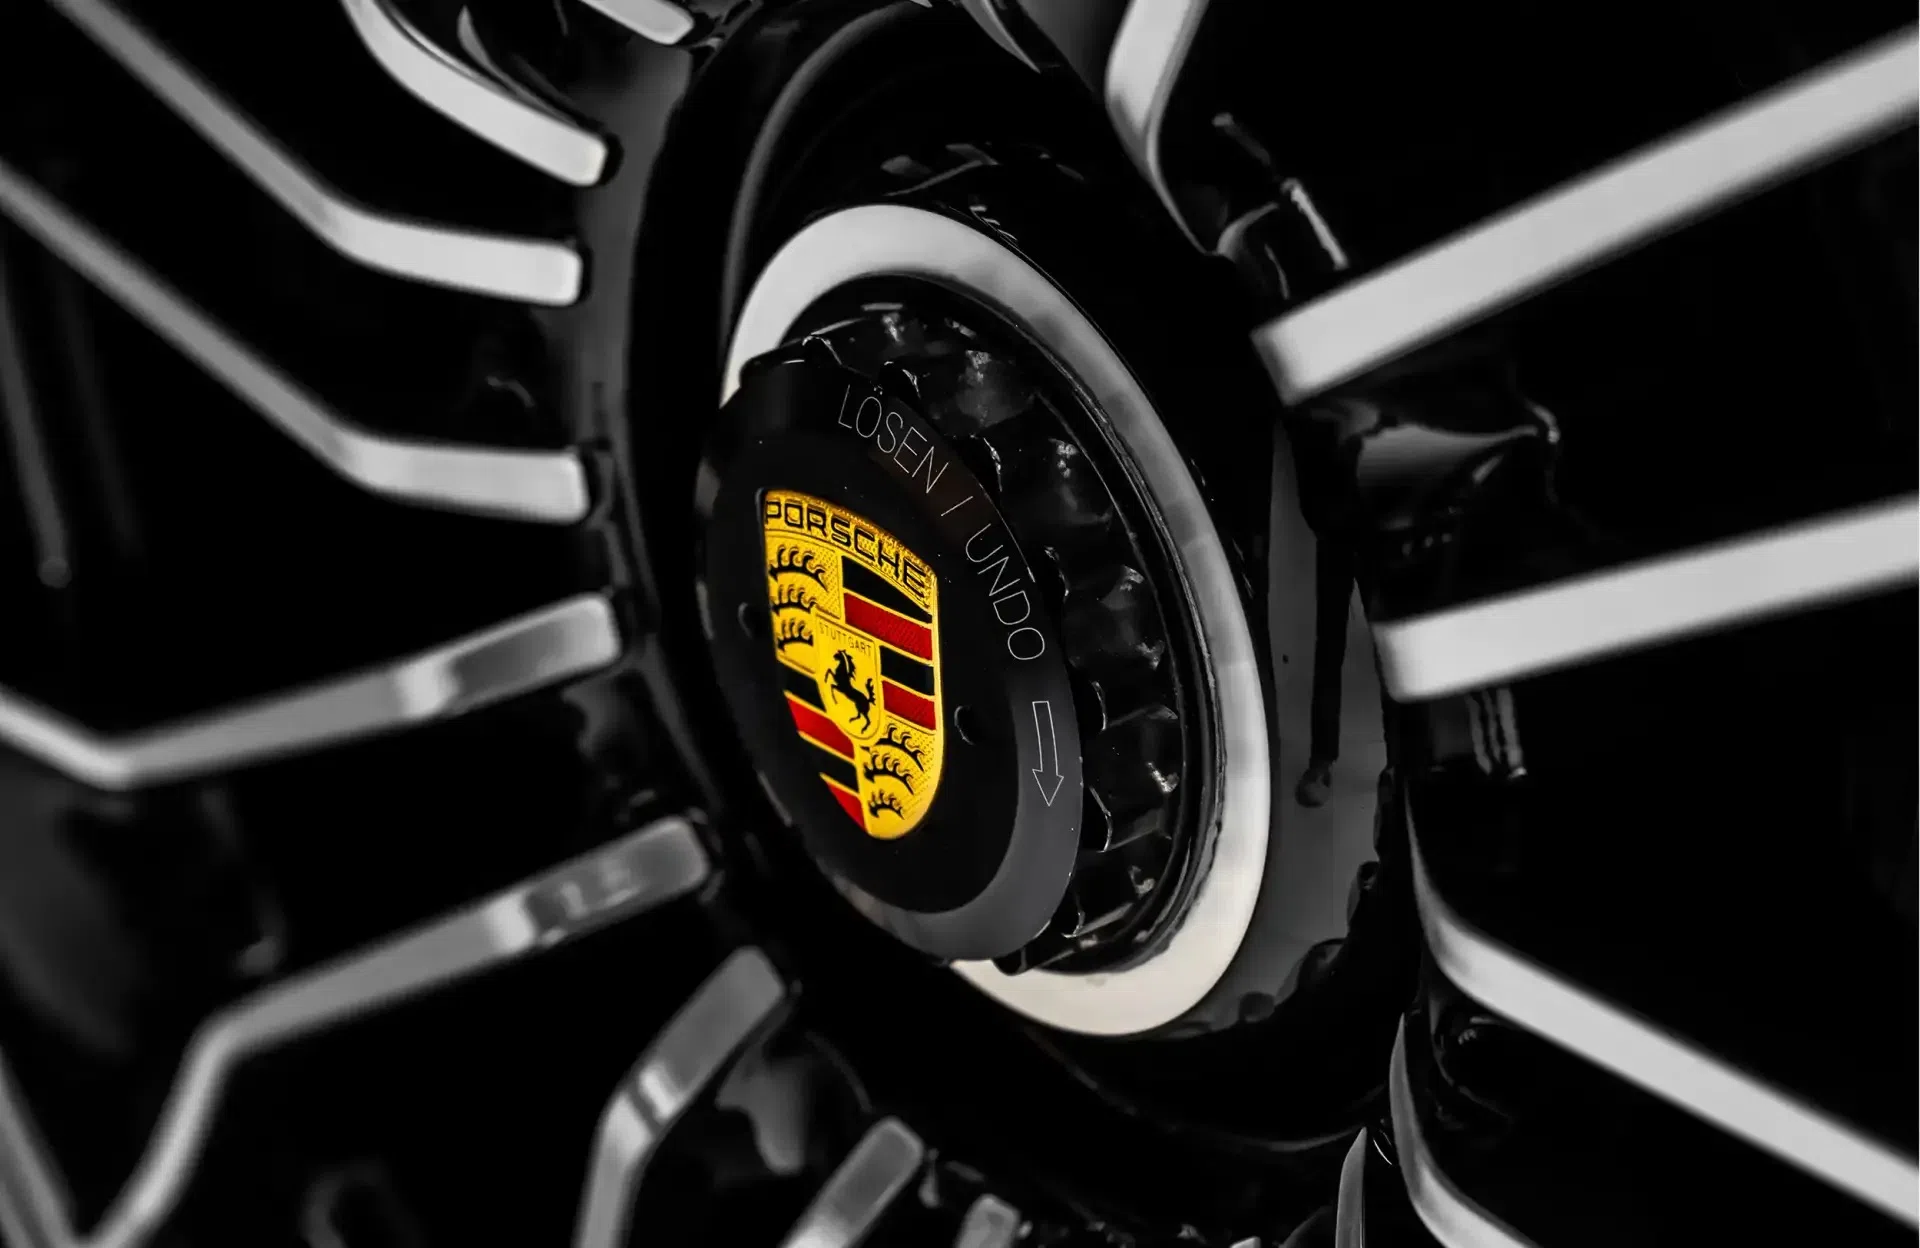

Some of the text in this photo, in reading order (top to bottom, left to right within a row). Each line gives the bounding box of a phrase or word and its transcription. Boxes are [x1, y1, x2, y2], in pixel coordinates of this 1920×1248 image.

[764, 500, 928, 599] PORSCHE
[837, 383, 1046, 661] LÖSEN / UNDO
[818, 621, 872, 656] STUTTGART
